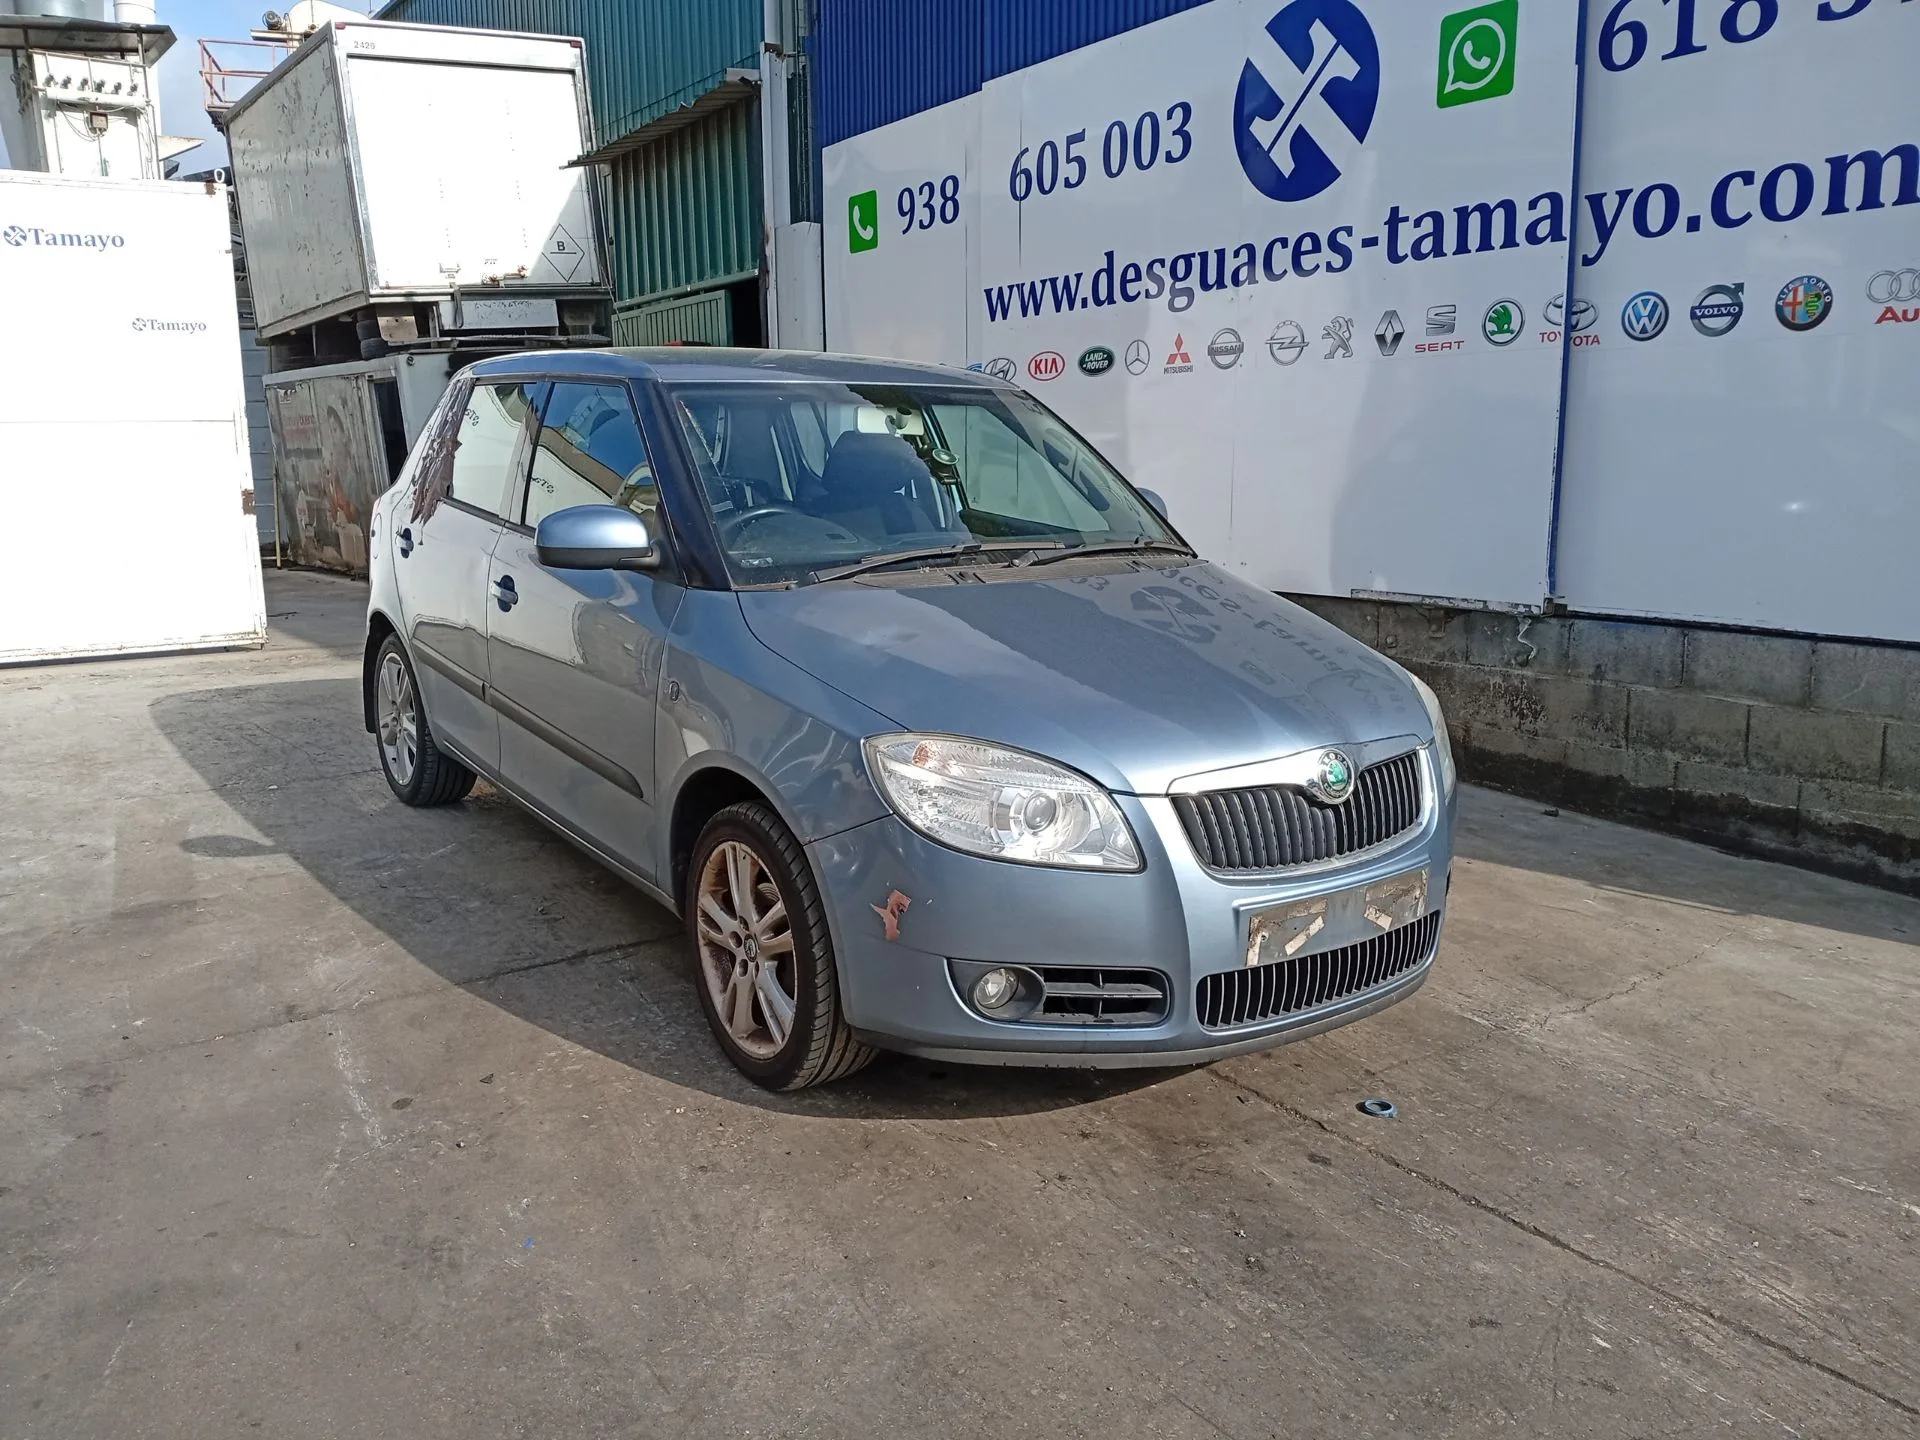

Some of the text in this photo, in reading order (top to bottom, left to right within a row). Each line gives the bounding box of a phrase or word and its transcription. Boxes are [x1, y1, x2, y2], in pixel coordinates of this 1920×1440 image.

[897, 101, 1192, 235] 938 605 003
[984, 143, 1920, 322] www.desguaces-tamayo.com
[28, 228, 125, 252] Tamayo
[556, 240, 566, 251] B
[1694, 305, 1739, 316] VOLVO
[146, 319, 207, 335] Tamayo
[1211, 344, 1241, 353] NISSAN
[1414, 340, 1464, 353] SEAT
[1085, 352, 1103, 361] LAND
[1034, 357, 1059, 375] KIA
[1087, 360, 1108, 370] ROVER
[1163, 365, 1193, 375] MITSUBISHI
